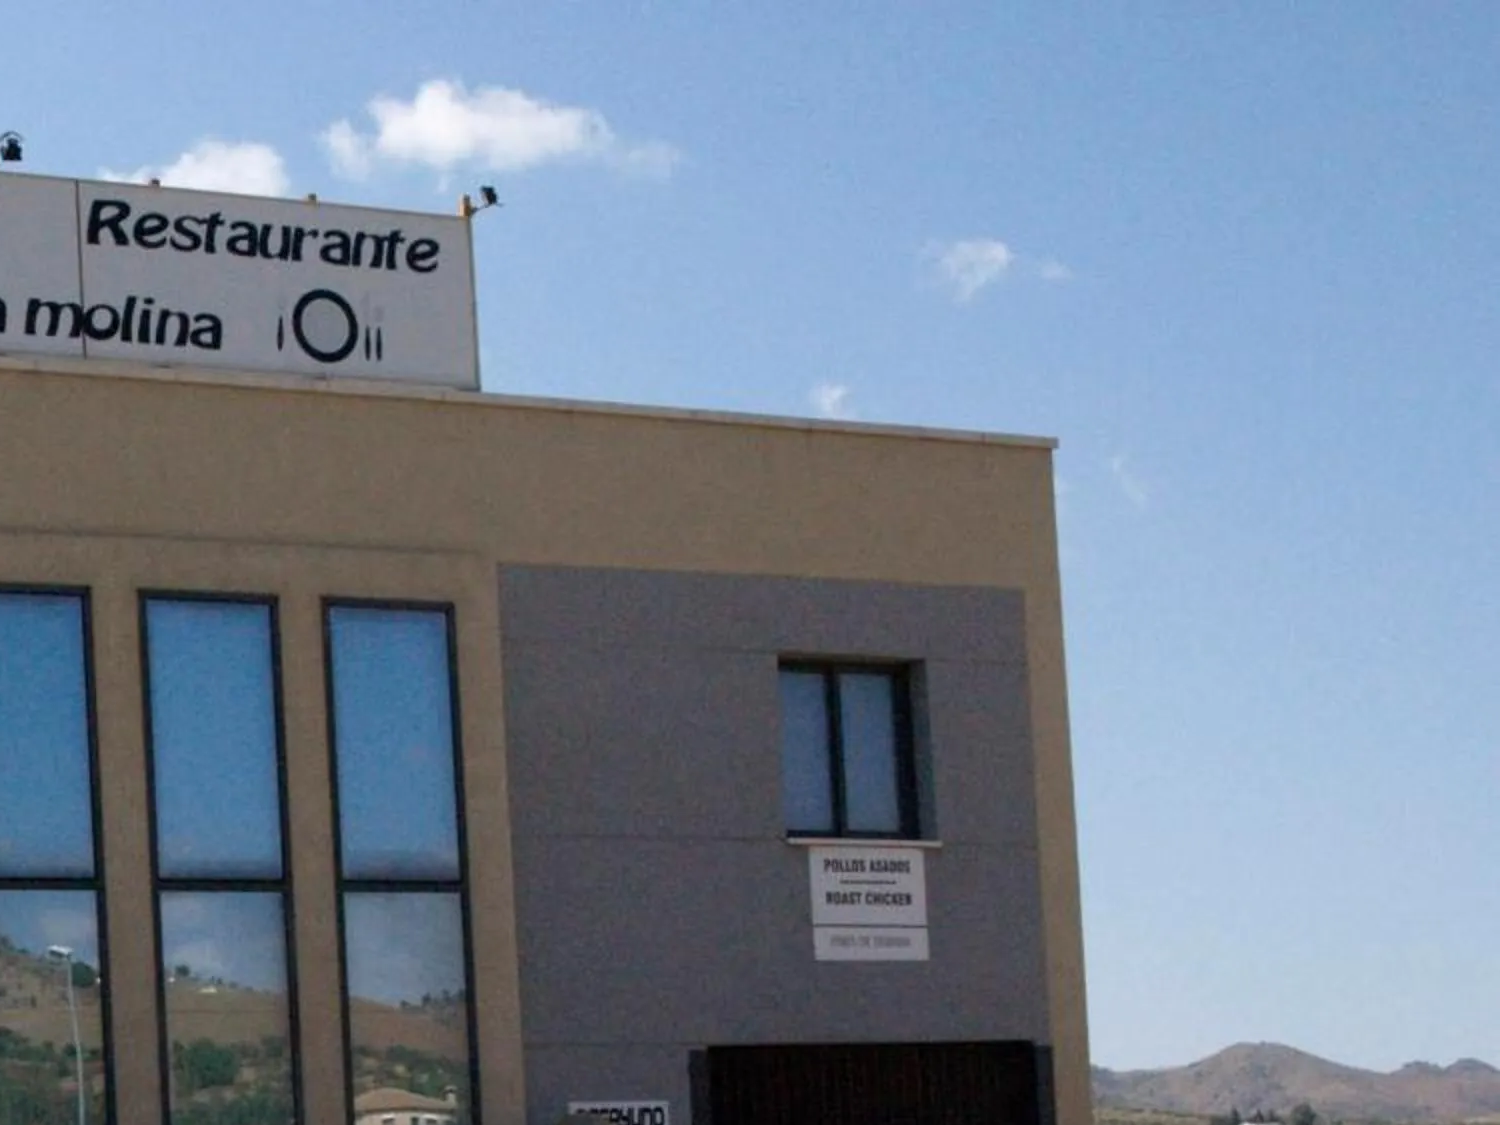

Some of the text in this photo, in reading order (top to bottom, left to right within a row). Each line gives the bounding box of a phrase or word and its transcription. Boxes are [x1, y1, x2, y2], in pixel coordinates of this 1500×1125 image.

[86, 199, 441, 274] Restaurante
[24, 294, 223, 350] molina
[823, 858, 866, 873] POLLOS
[825, 891, 912, 907] ROAST CHICKEN
